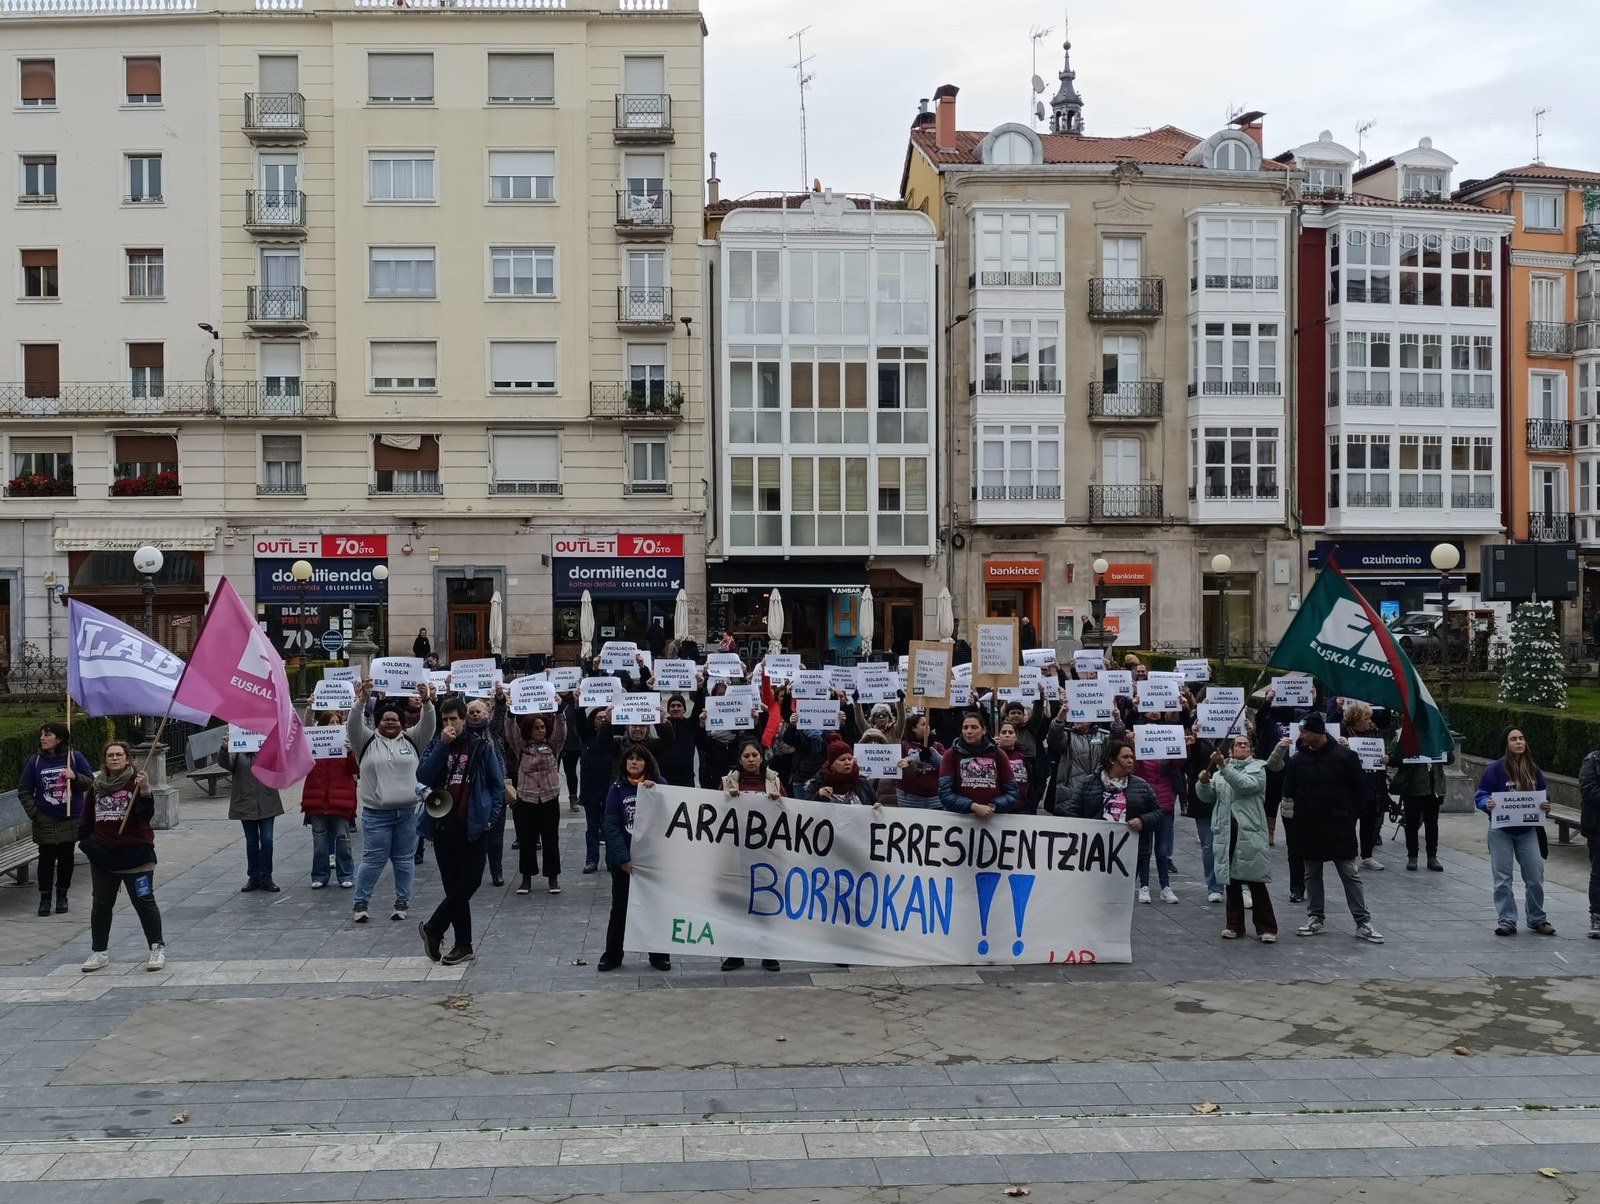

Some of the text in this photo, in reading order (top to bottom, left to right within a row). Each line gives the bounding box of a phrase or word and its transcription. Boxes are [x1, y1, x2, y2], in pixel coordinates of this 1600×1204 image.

[256, 542, 318, 553] OUTLET
[336, 540, 359, 554] 70
[555, 541, 616, 552] OUTLET
[633, 540, 656, 554] 70
[1362, 554, 1422, 564] azulmarino
[272, 569, 372, 582] doitienda
[569, 566, 667, 578] dormitienda
[282, 607, 318, 615] BLACK
[78, 624, 182, 674] LAB
[1309, 640, 1356, 668] EUSKAL
[230, 675, 272, 700] EUSKAL
[665, 801, 835, 856] ARABAKO
[870, 822, 1130, 877] ERRESIDENTZIAK
[748, 863, 953, 935] BORROKAN
[671, 918, 714, 945] ELA
